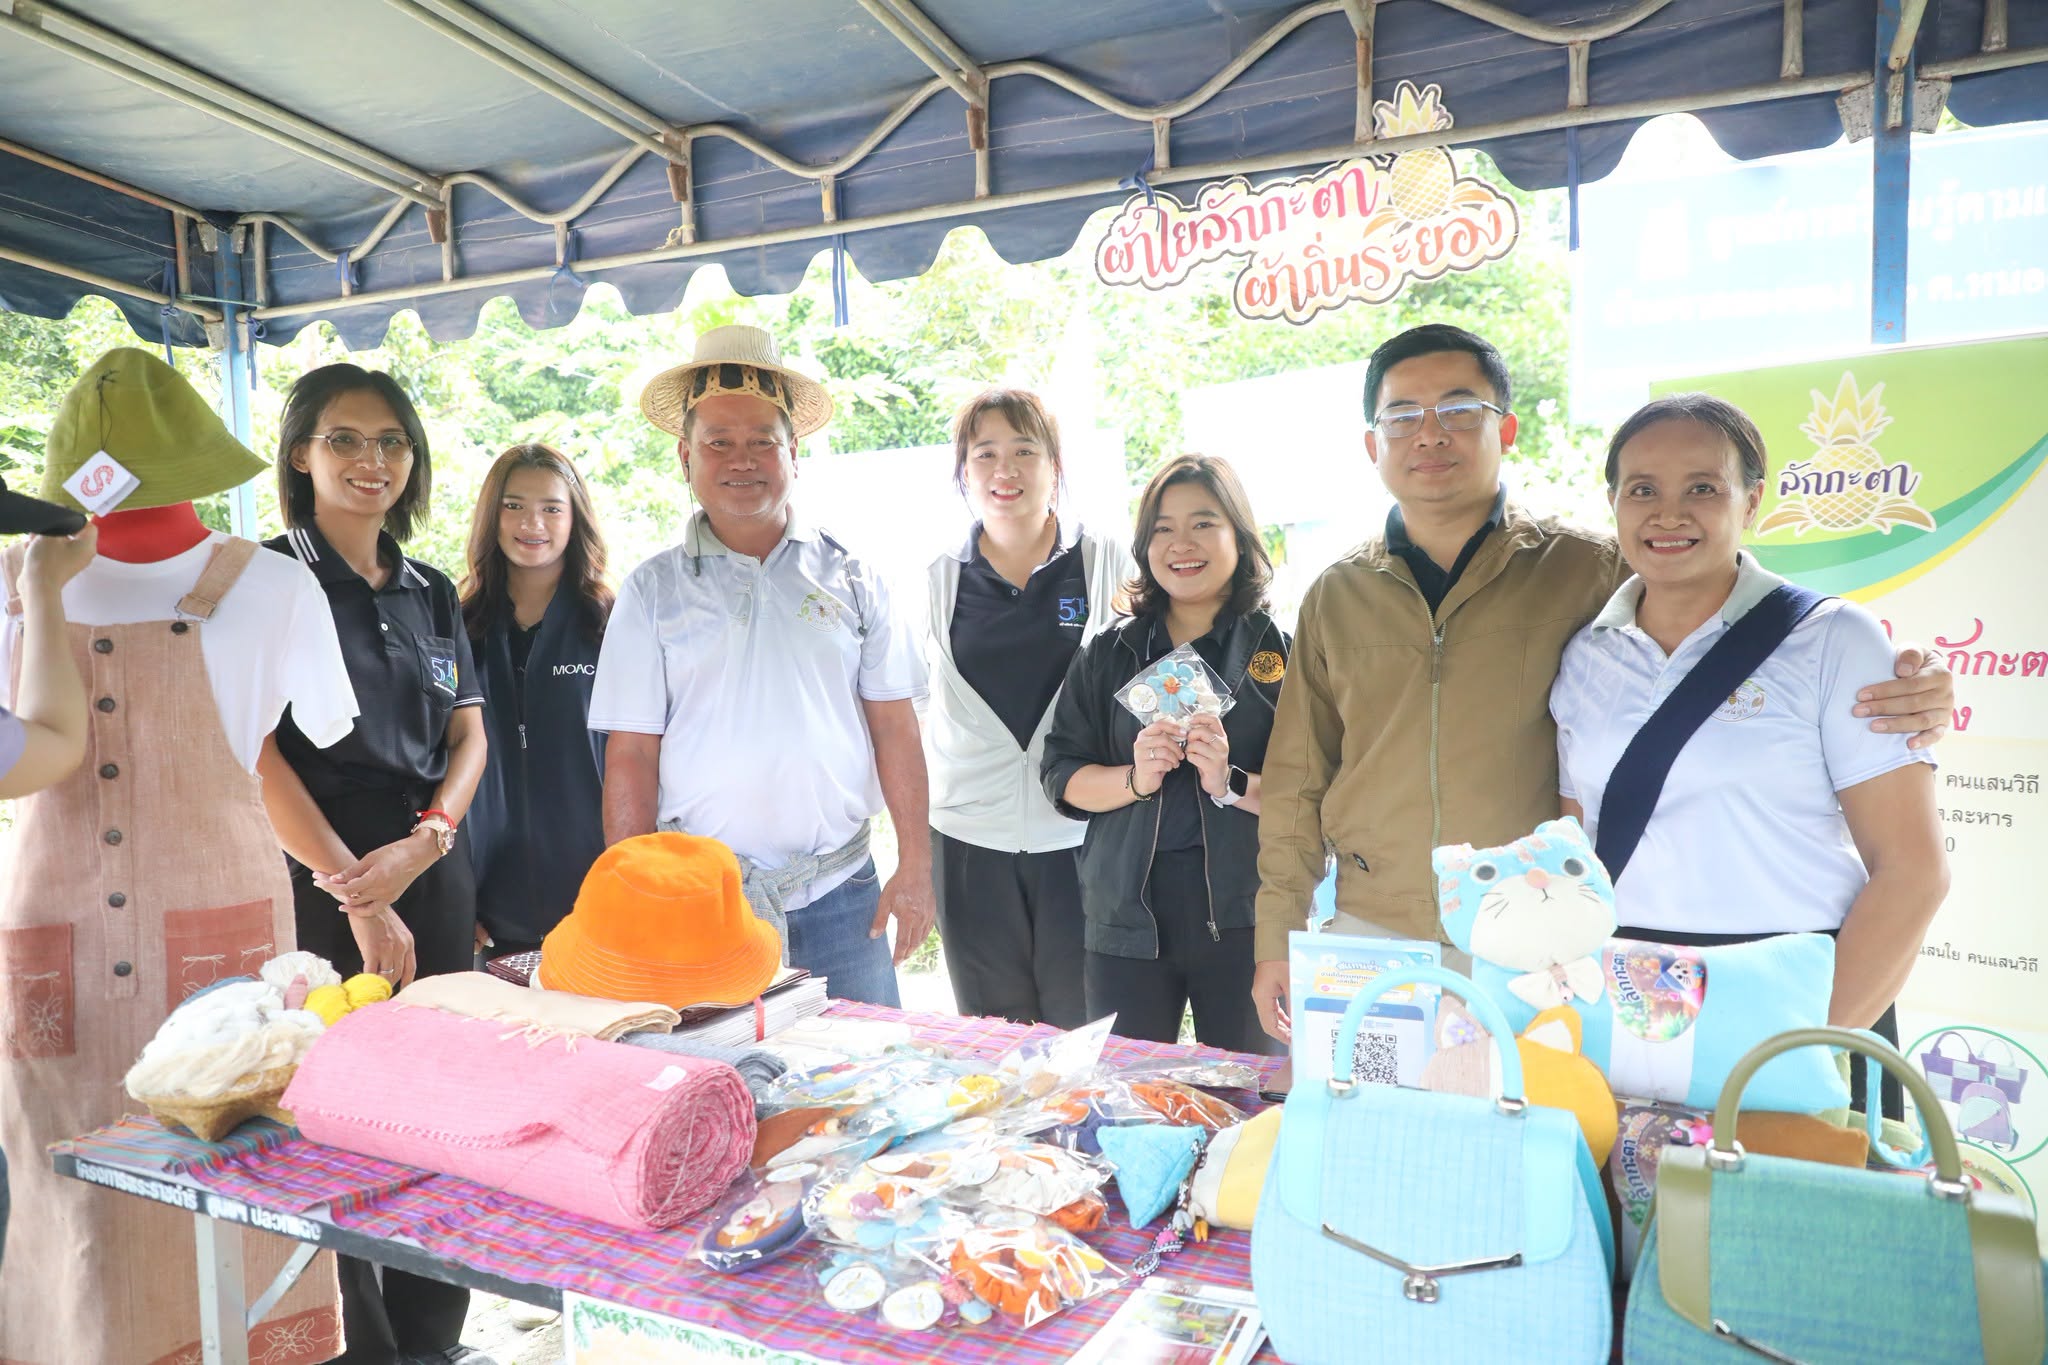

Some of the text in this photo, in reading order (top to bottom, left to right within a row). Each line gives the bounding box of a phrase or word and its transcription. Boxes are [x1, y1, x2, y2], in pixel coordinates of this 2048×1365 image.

[1244, 209, 1502, 312] ผ้าถิ่นระยอง
[1780, 462, 1918, 496] ลักกะตา
[1933, 617, 2048, 677] ักกะต
[553, 664, 595, 676] MOAC
[1946, 773, 2040, 794] คนแสนวิถี
[1967, 952, 2039, 973] คนแสนวิถี
